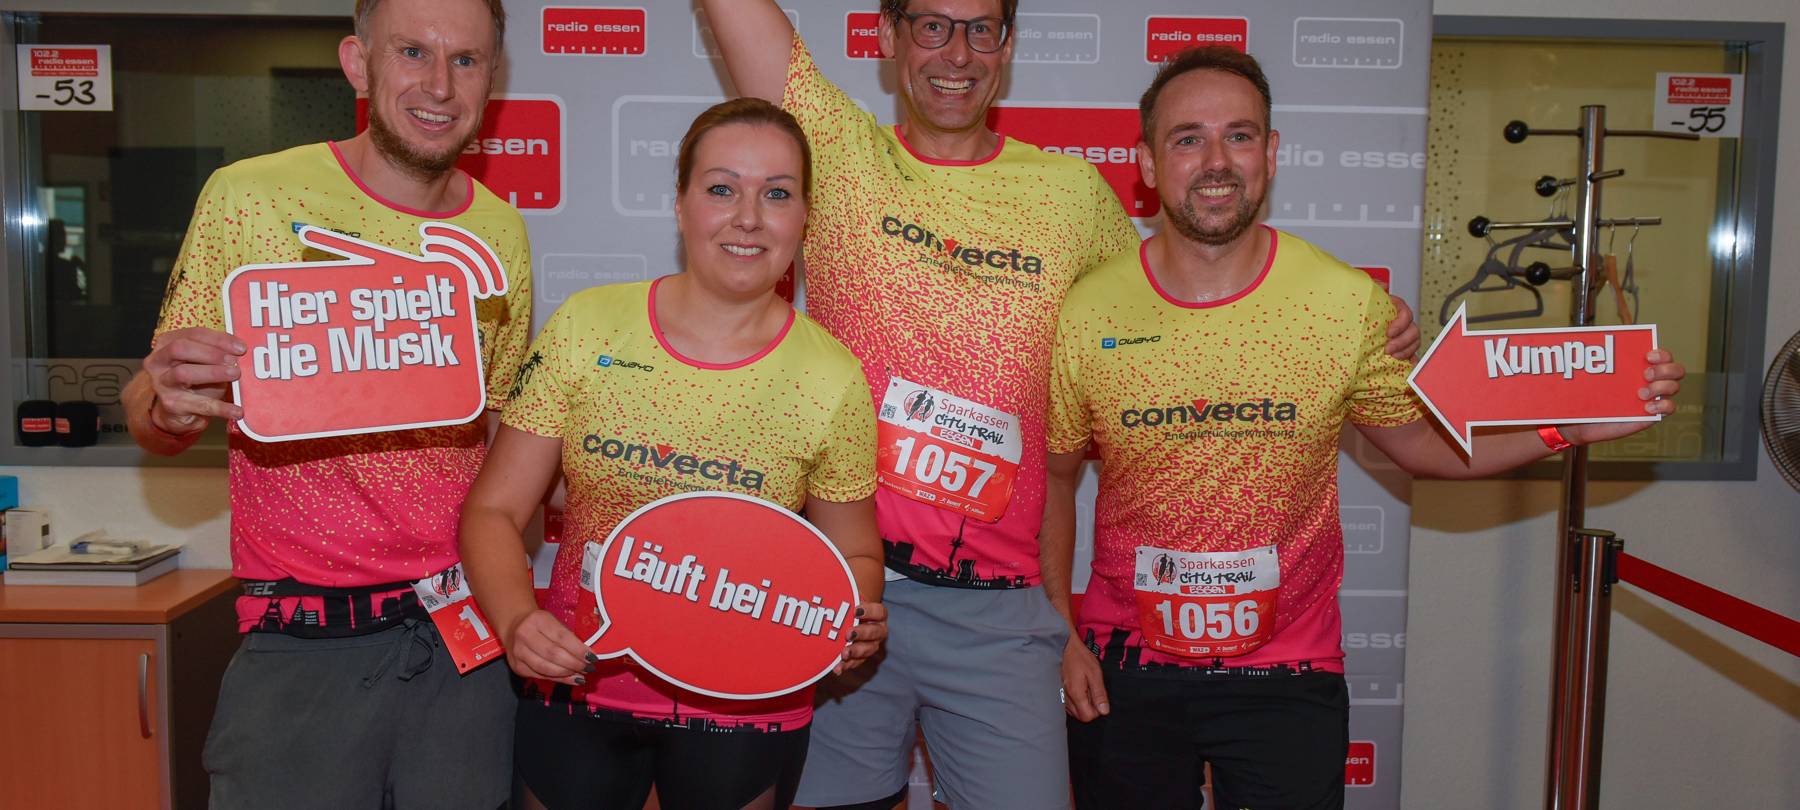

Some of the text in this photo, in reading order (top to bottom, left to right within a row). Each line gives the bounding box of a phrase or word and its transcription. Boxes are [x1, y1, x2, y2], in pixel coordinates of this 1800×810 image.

[547, 22, 641, 33] radio essen
[1018, 28, 1093, 41] dio essen
[1151, 31, 1242, 42] radio essen
[1300, 34, 1396, 45] radio essen
[36, 79, 96, 105] -53
[1671, 107, 1726, 132] -55
[461, 137, 548, 156] ssen
[1278, 144, 1325, 168] dio
[881, 216, 1042, 275] convecta
[248, 274, 456, 332] Hier spielt
[253, 321, 460, 380] die Musik
[1484, 334, 1615, 379] Kumpel
[939, 398, 1009, 431] Sparkassen
[1121, 398, 1297, 429] convecta
[583, 434, 764, 491] convecta
[894, 436, 997, 499] 1057
[1179, 556, 1256, 571] Sparkassen
[243, 581, 277, 596] TEC
[613, 535, 850, 641] Läuft bei mir!
[1156, 599, 1260, 640] 1056
